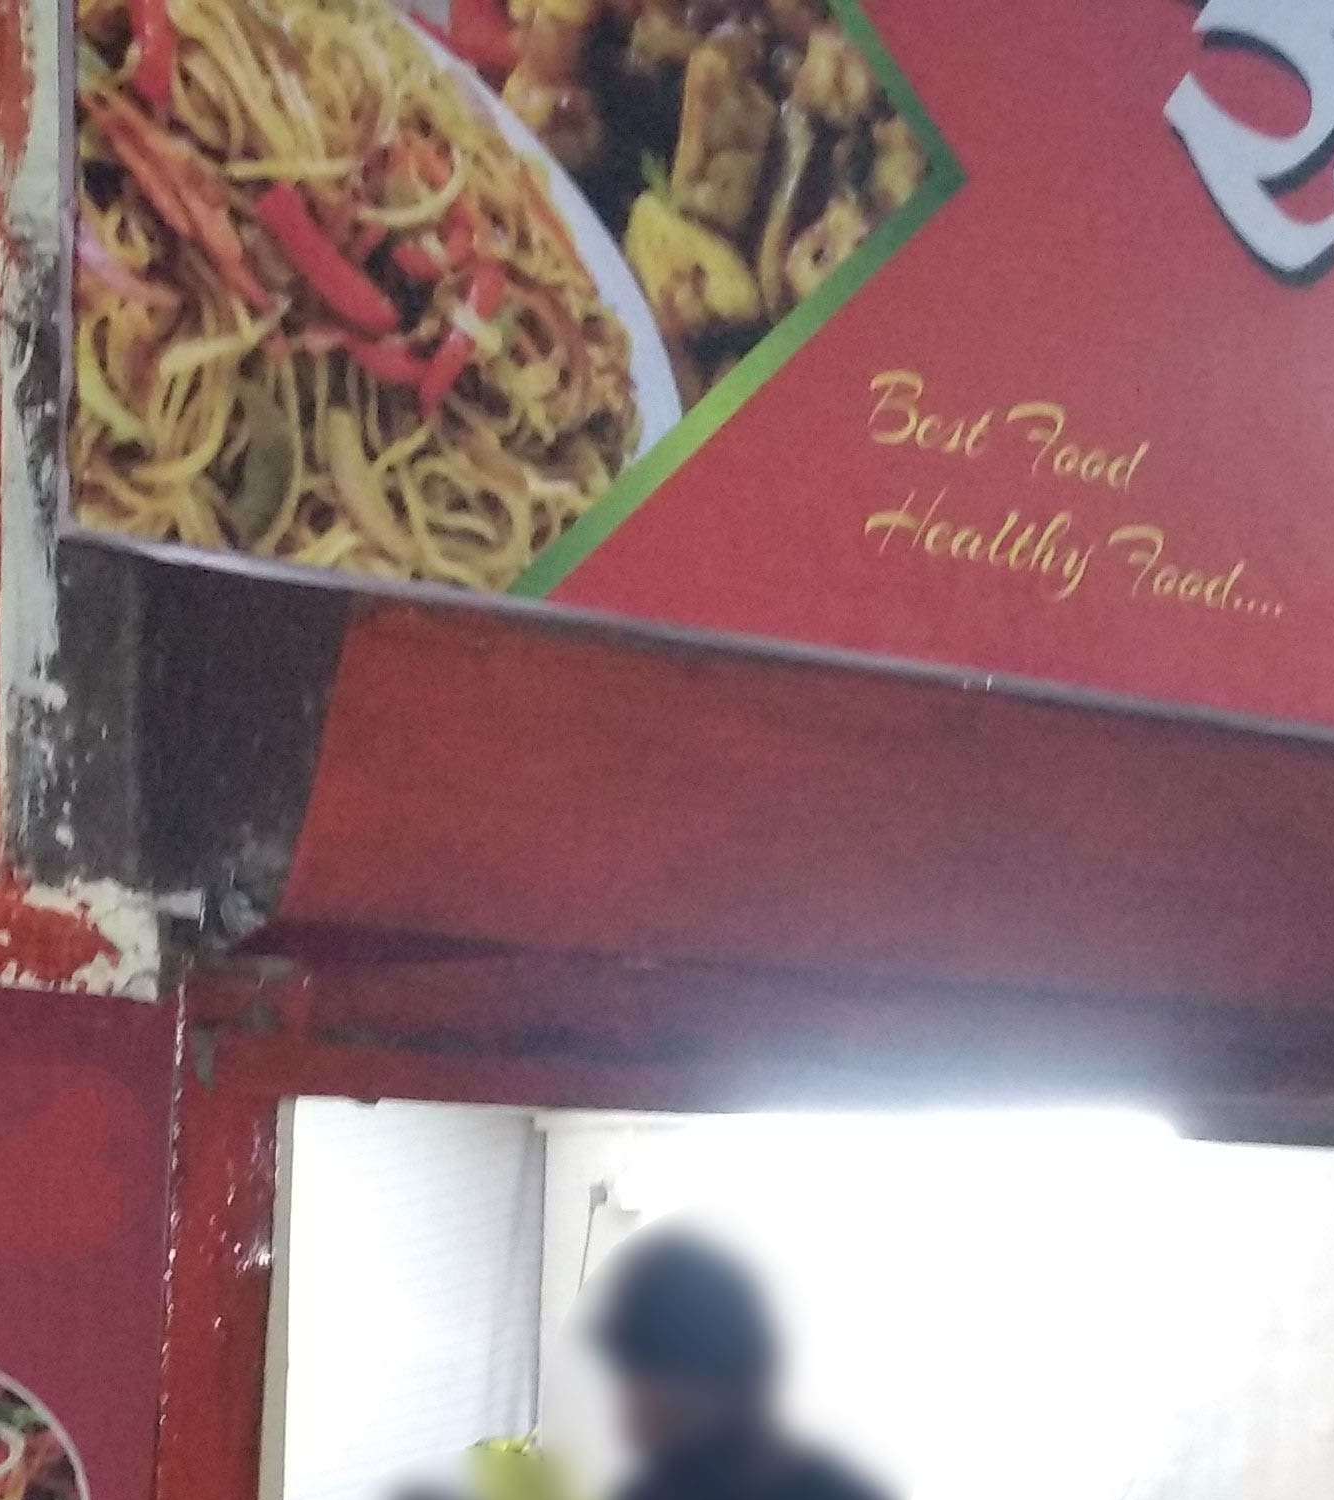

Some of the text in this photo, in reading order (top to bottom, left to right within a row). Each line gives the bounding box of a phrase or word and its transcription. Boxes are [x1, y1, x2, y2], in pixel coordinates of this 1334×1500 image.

[869, 368, 1151, 493] Best Food
[865, 487, 1095, 601] Healthy
